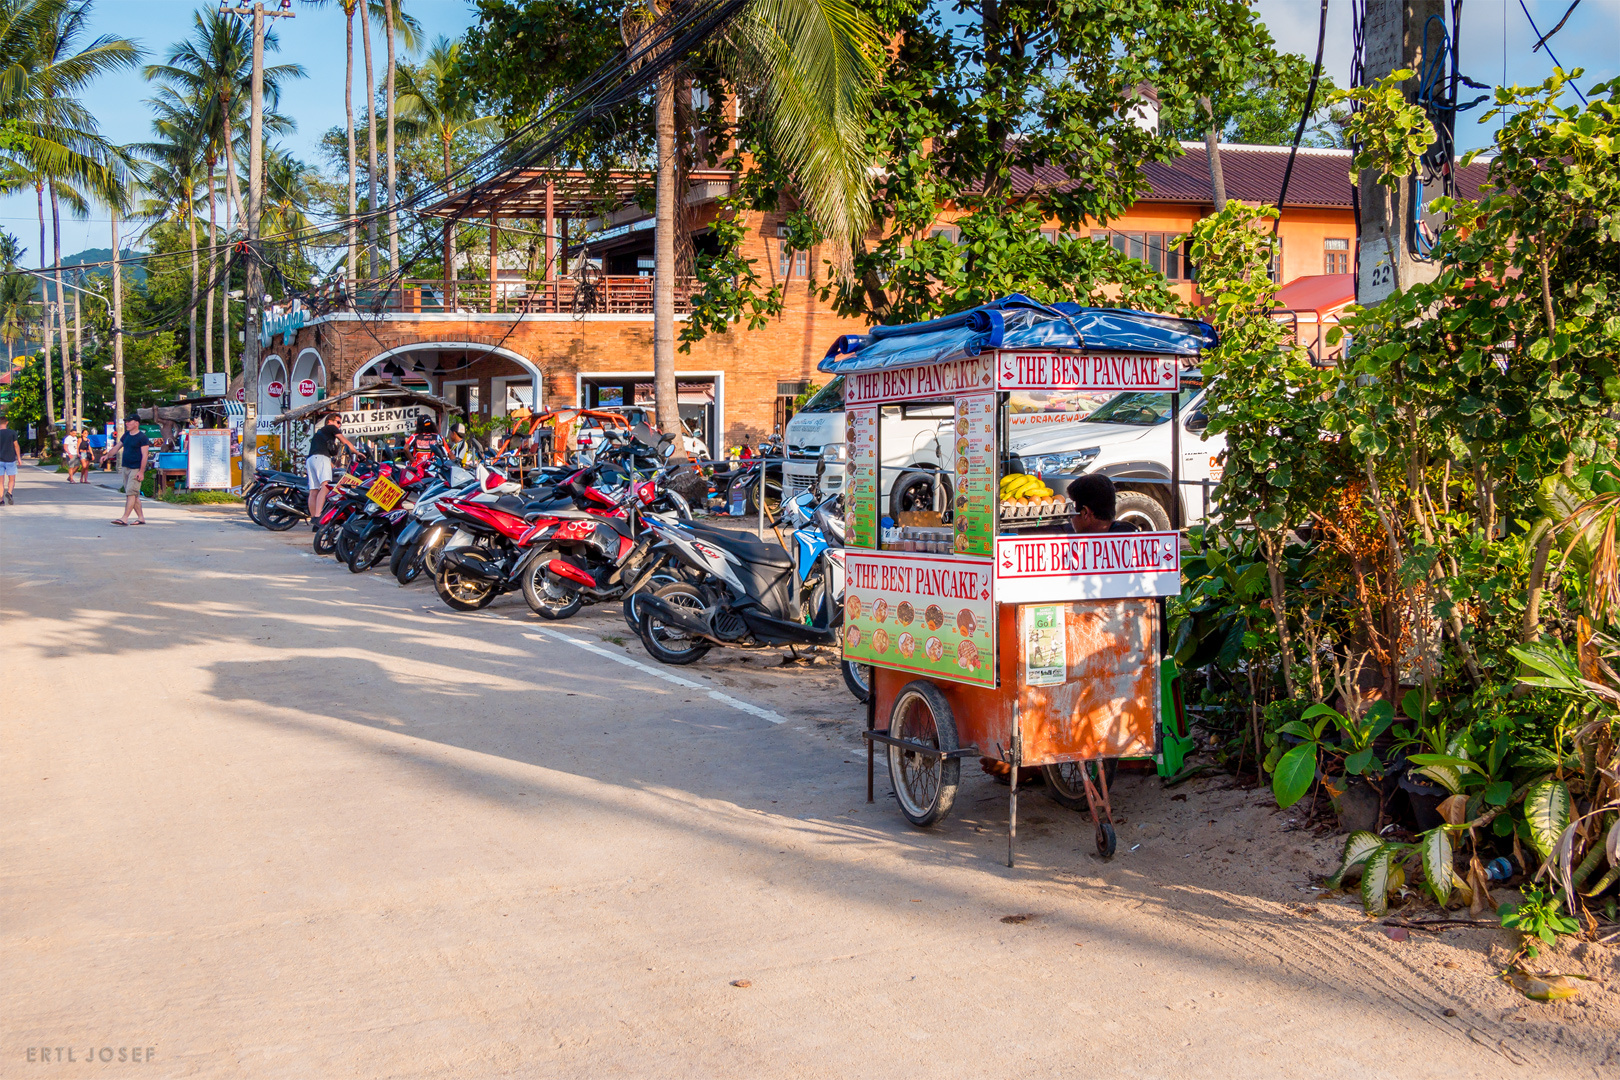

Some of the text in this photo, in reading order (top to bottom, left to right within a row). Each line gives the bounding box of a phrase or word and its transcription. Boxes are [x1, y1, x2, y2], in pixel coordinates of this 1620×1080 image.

[1372, 266, 1390, 286] 22
[856, 358, 980, 400] THE BEST PANCAKE
[1016, 356, 1160, 385] THE BEST PANCAKE
[342, 408, 420, 424] AXI SERVICE
[370, 480, 386, 499] FOR
[379, 486, 400, 507] RENT
[1015, 539, 1160, 572] THE BEST PANCAKE
[855, 563, 978, 600] THE BEST PANCAKE
